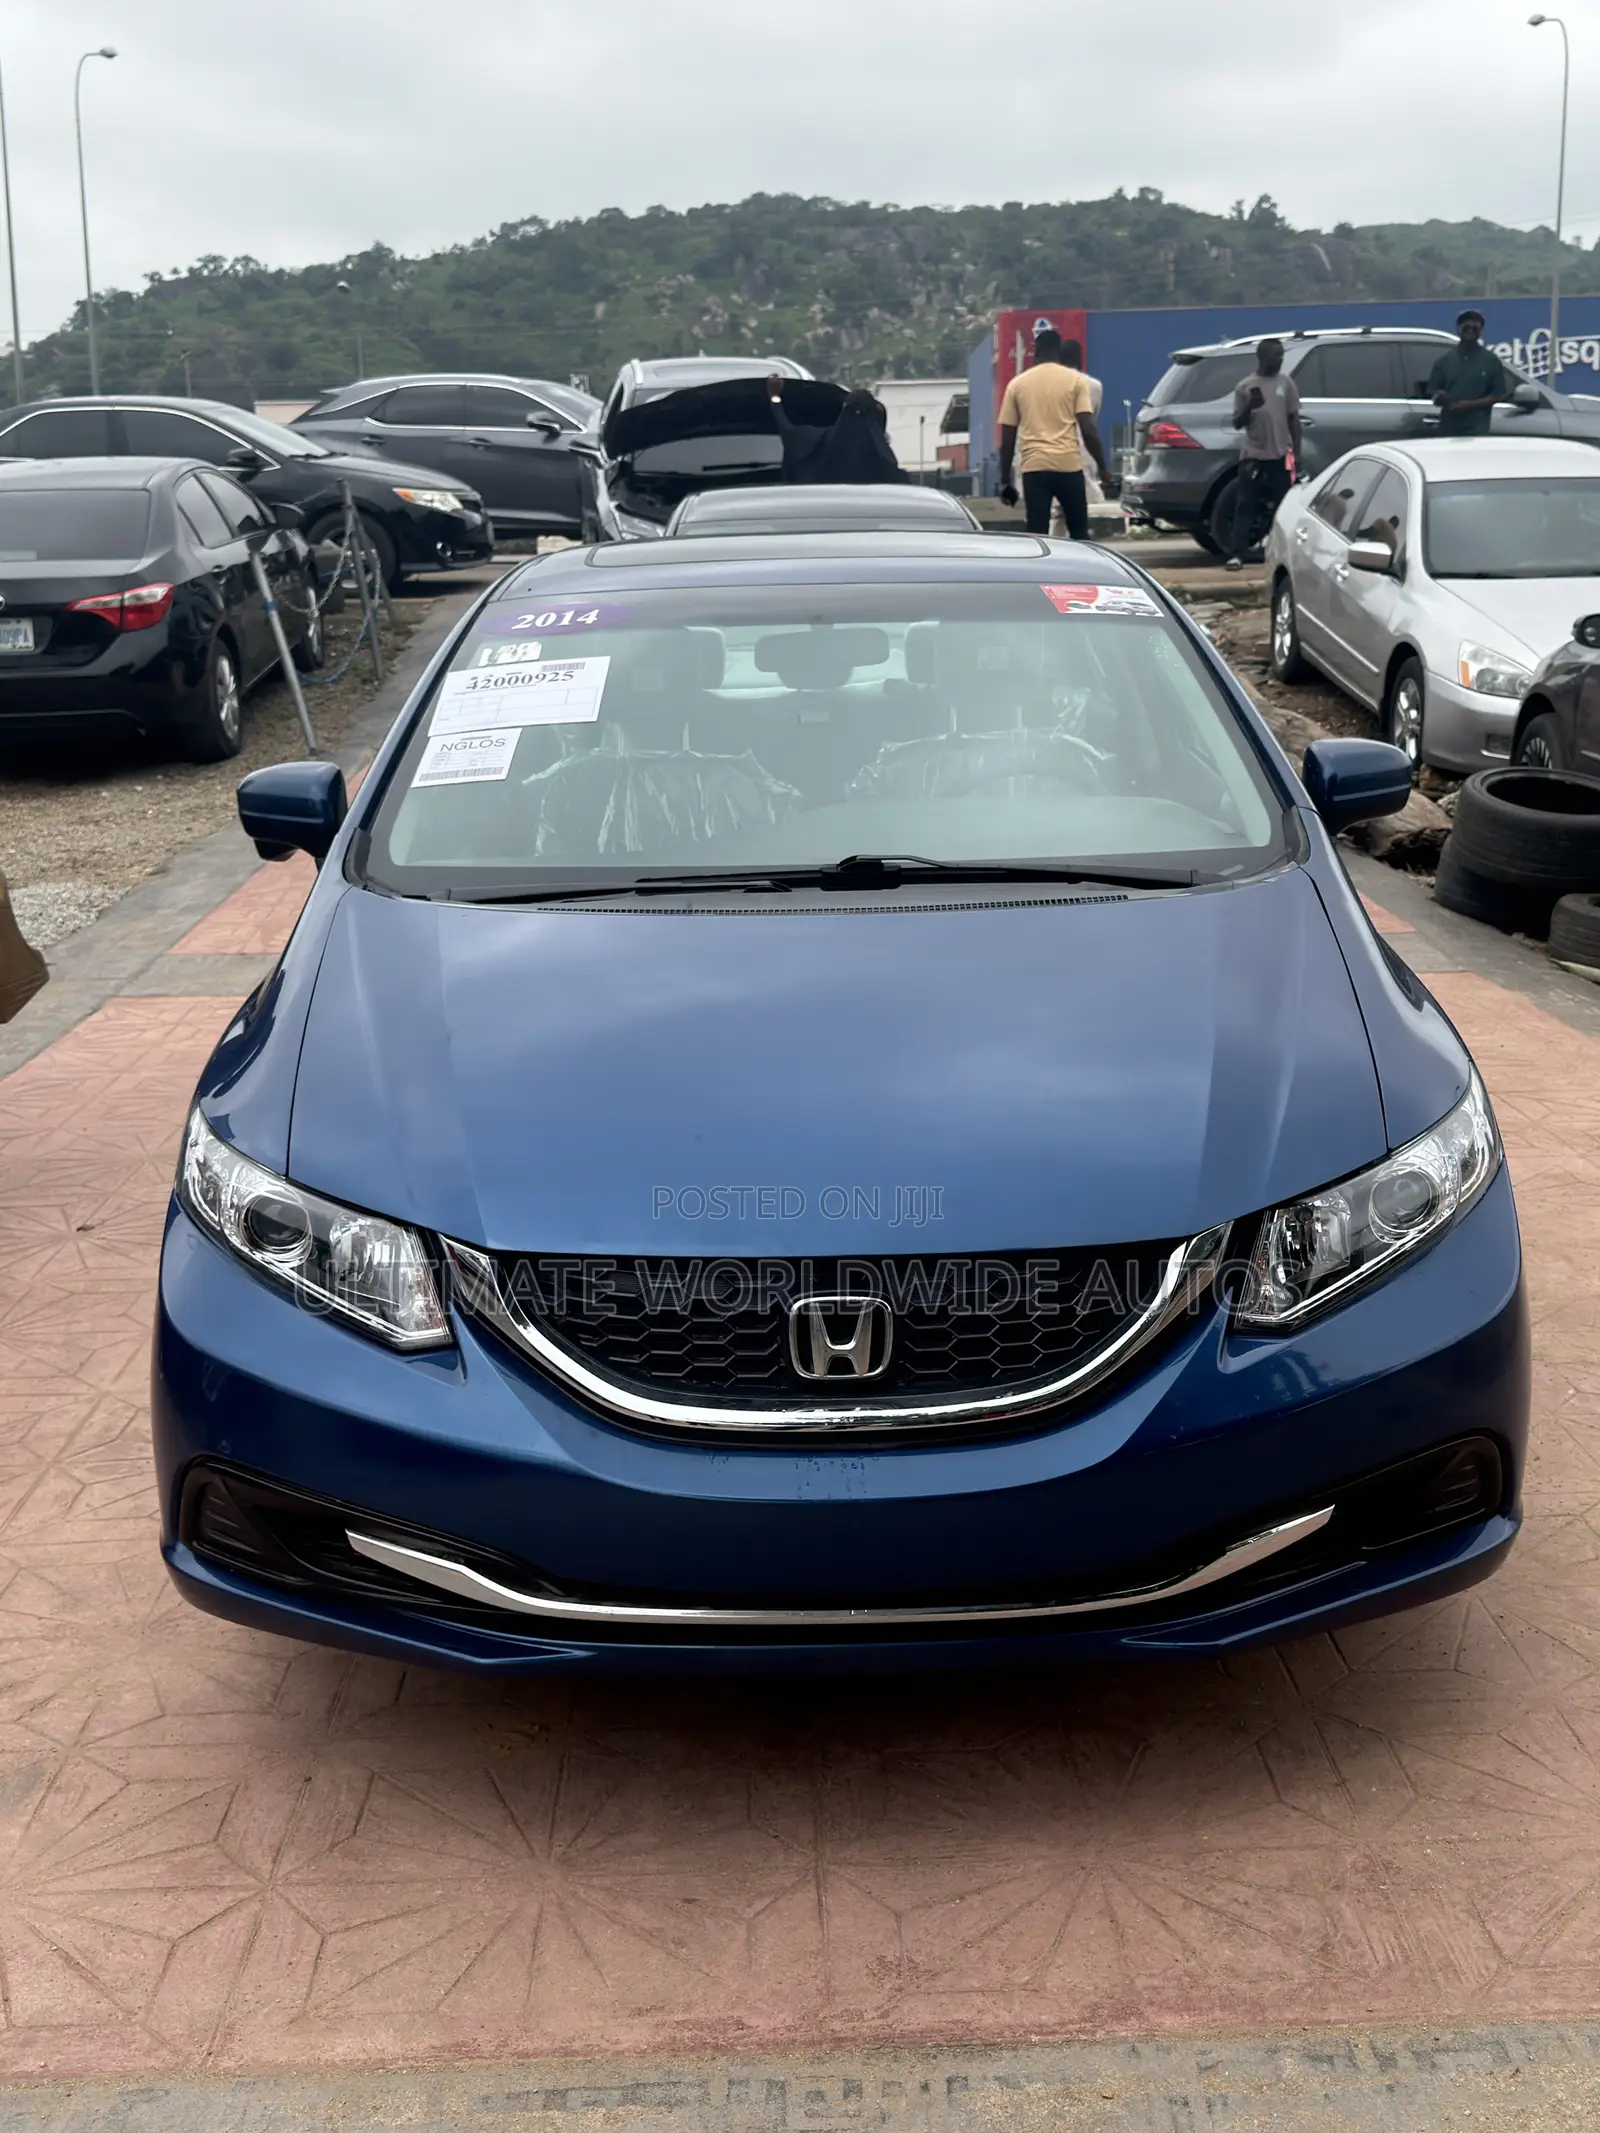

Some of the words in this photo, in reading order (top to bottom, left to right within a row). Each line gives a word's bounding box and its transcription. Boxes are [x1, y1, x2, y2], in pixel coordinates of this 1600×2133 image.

[511, 608, 600, 630] 2014
[466, 671, 575, 690] 42000925
[440, 738, 507, 752] NGLOS
